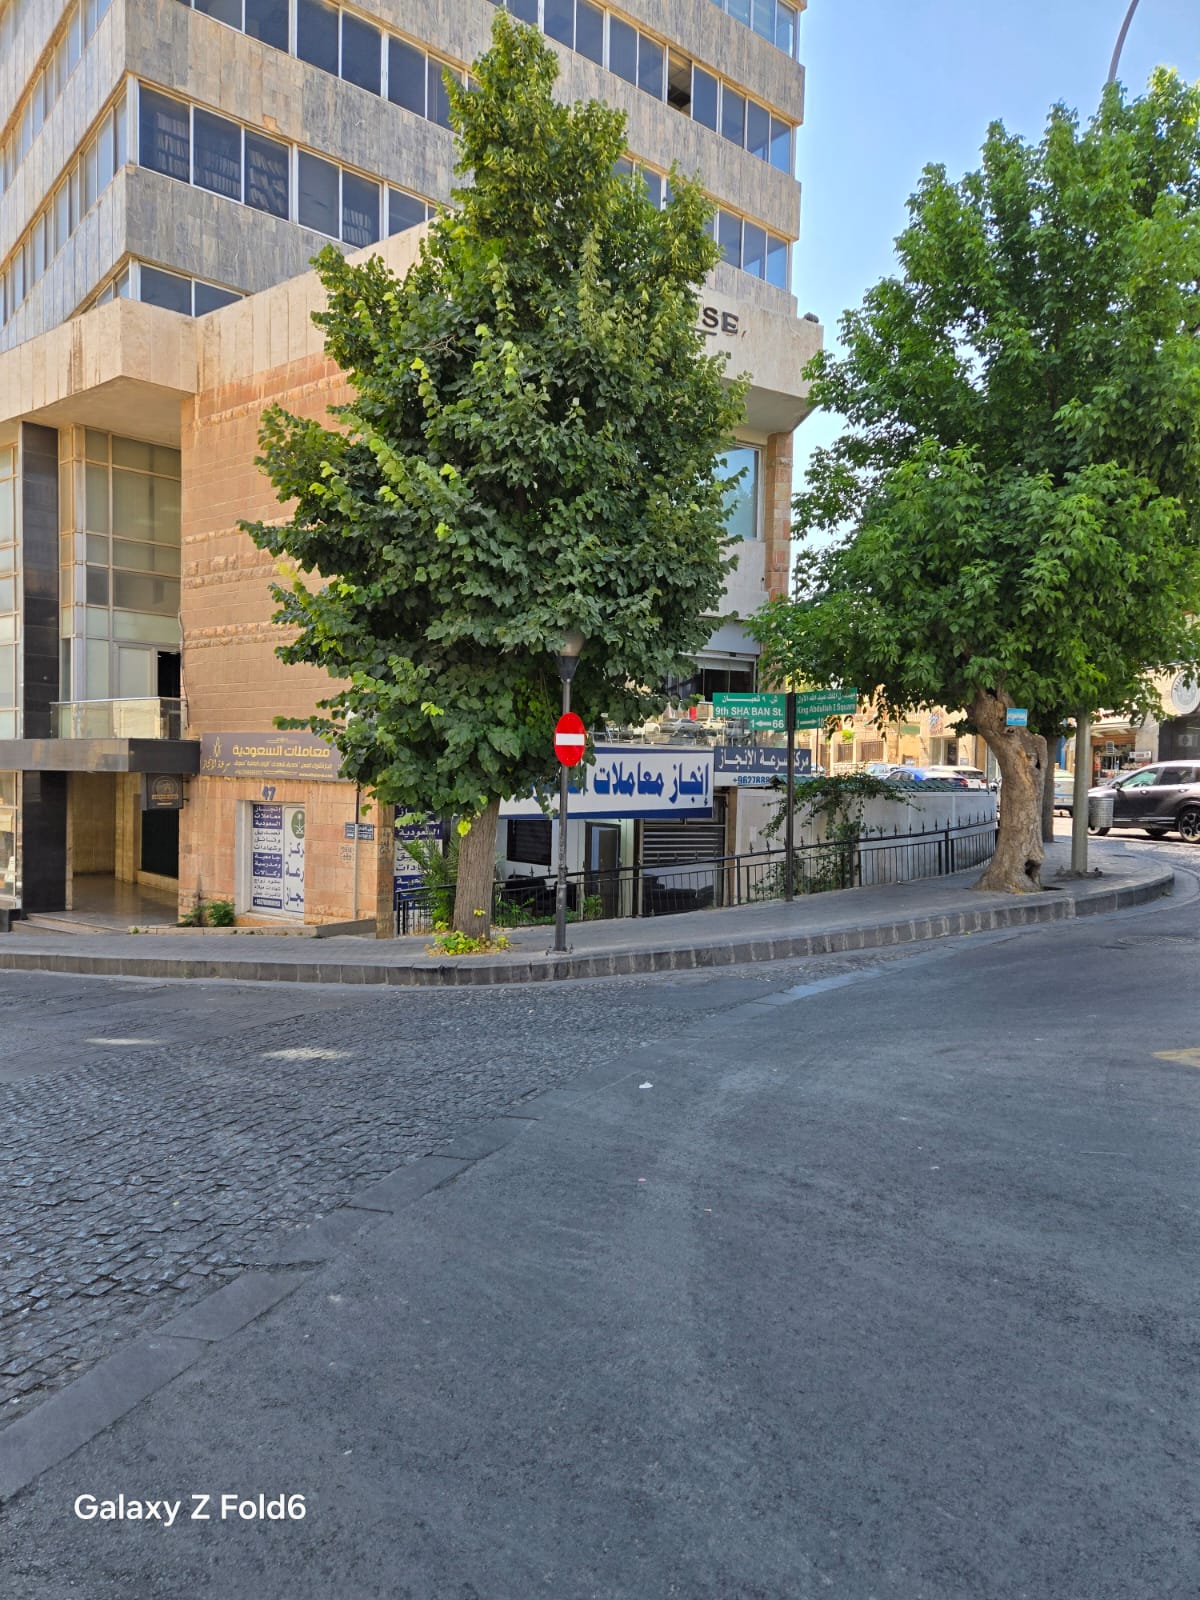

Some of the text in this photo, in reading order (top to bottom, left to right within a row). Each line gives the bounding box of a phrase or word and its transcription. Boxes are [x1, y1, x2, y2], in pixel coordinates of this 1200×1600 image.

[715, 706, 729, 715] 9th
[772, 719, 785, 729] 66
[232, 744, 331, 758] معاملات السعودية
[593, 760, 665, 797] معاملات
[668, 762, 709, 806] إنجاز
[262, 786, 276, 800] 47
